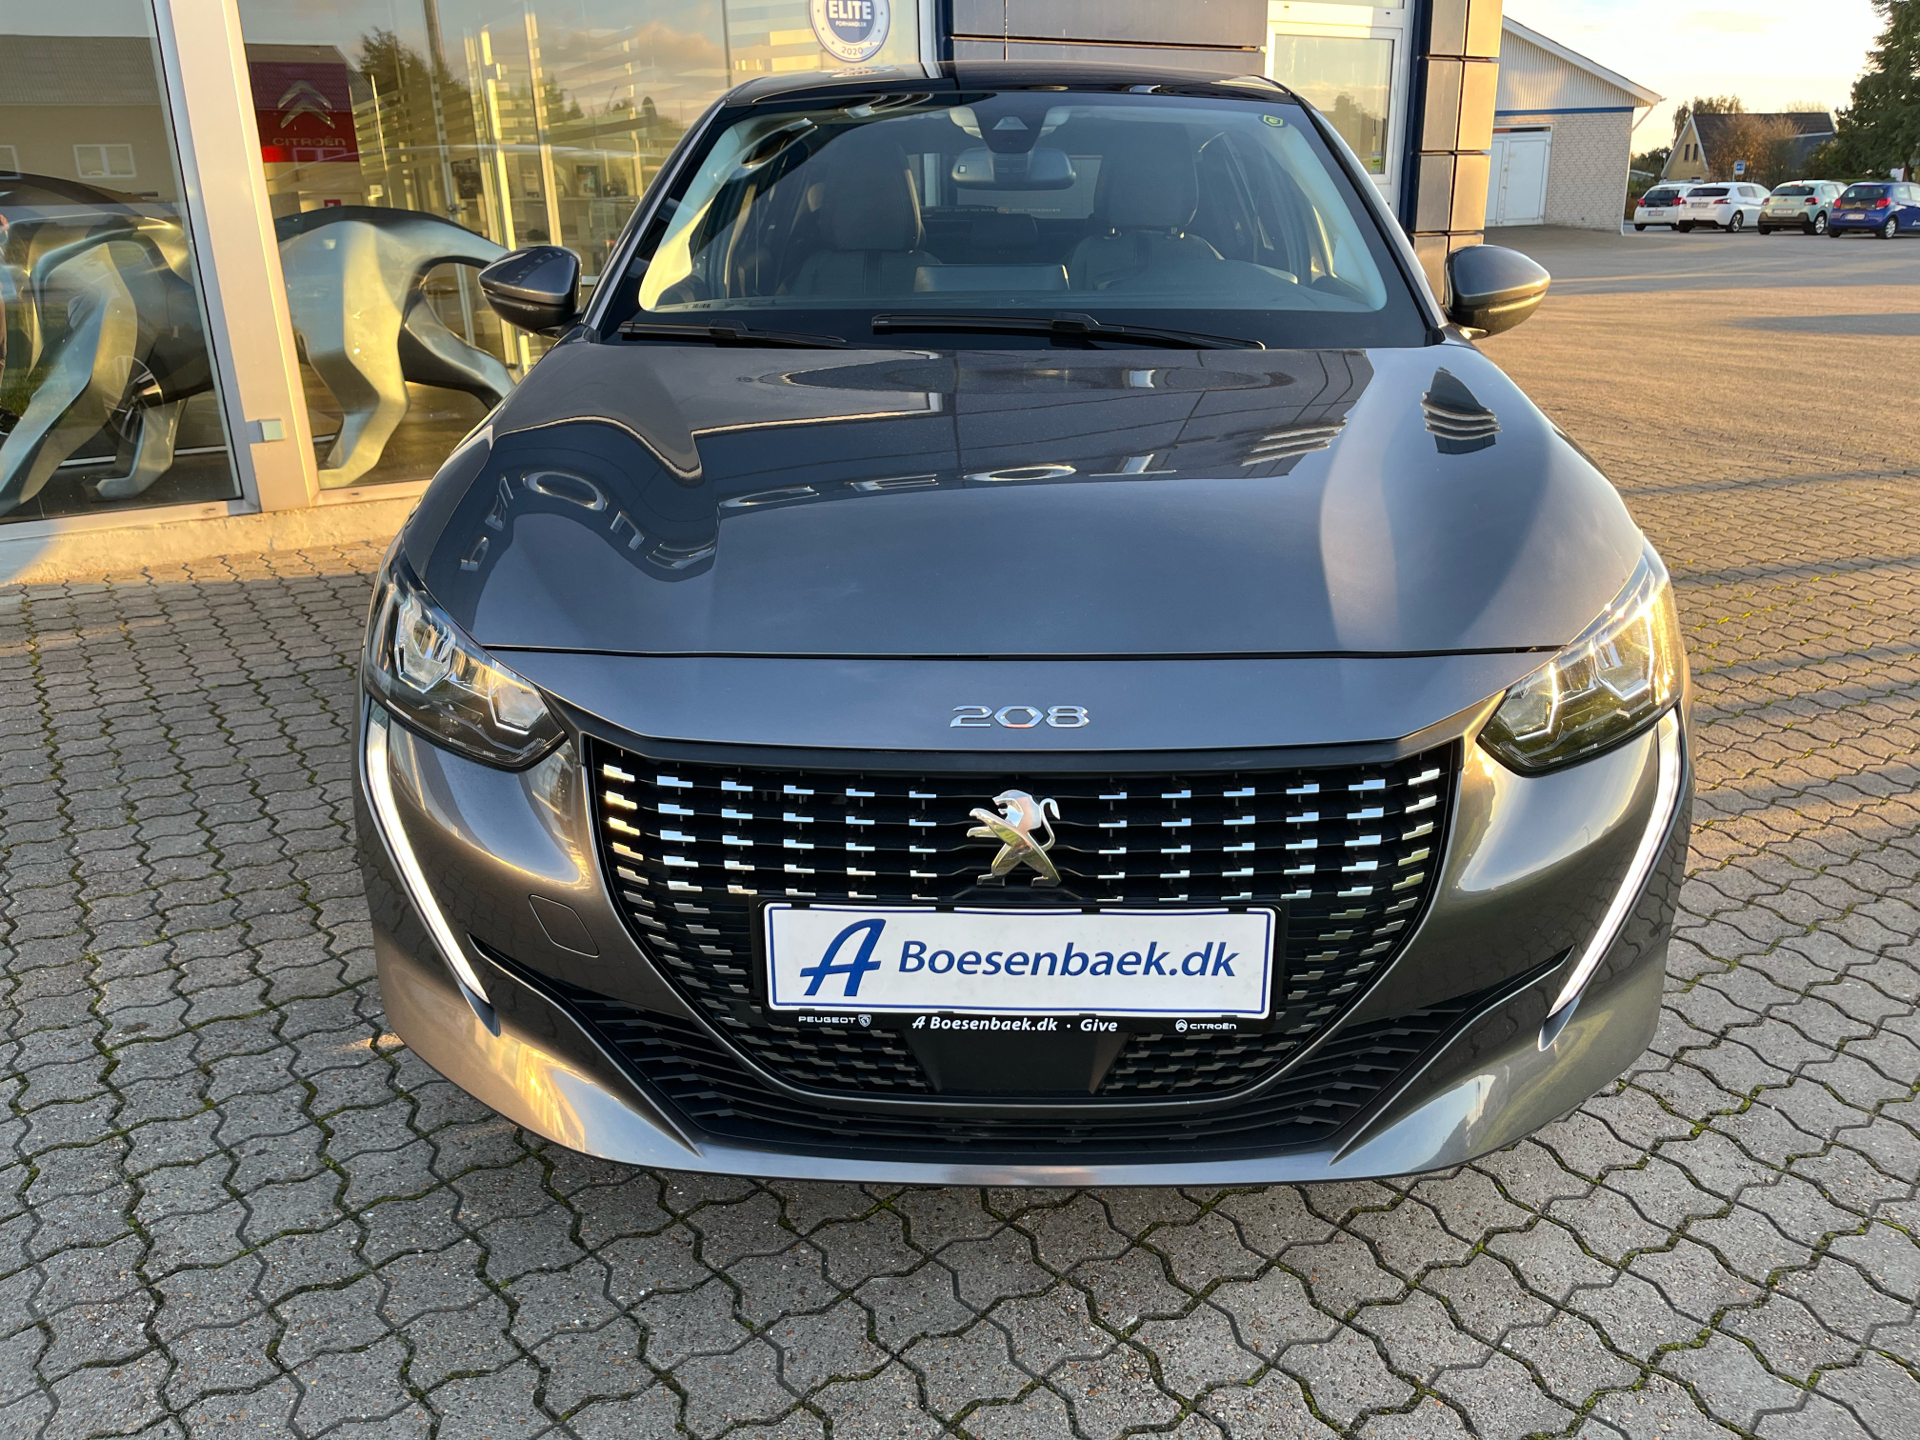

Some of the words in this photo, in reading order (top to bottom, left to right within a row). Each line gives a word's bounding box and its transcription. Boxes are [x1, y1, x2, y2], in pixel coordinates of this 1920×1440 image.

[828, 0, 872, 19] ELITE
[841, 46, 864, 56] 2020
[950, 705, 1090, 728] 208
[898, 940, 1239, 977] Boesenbaek.dk
[798, 1016, 856, 1024] PEUGEOT
[929, 1016, 1058, 1031] Boesenbaek.dk
[1080, 1019, 1118, 1032] Give
